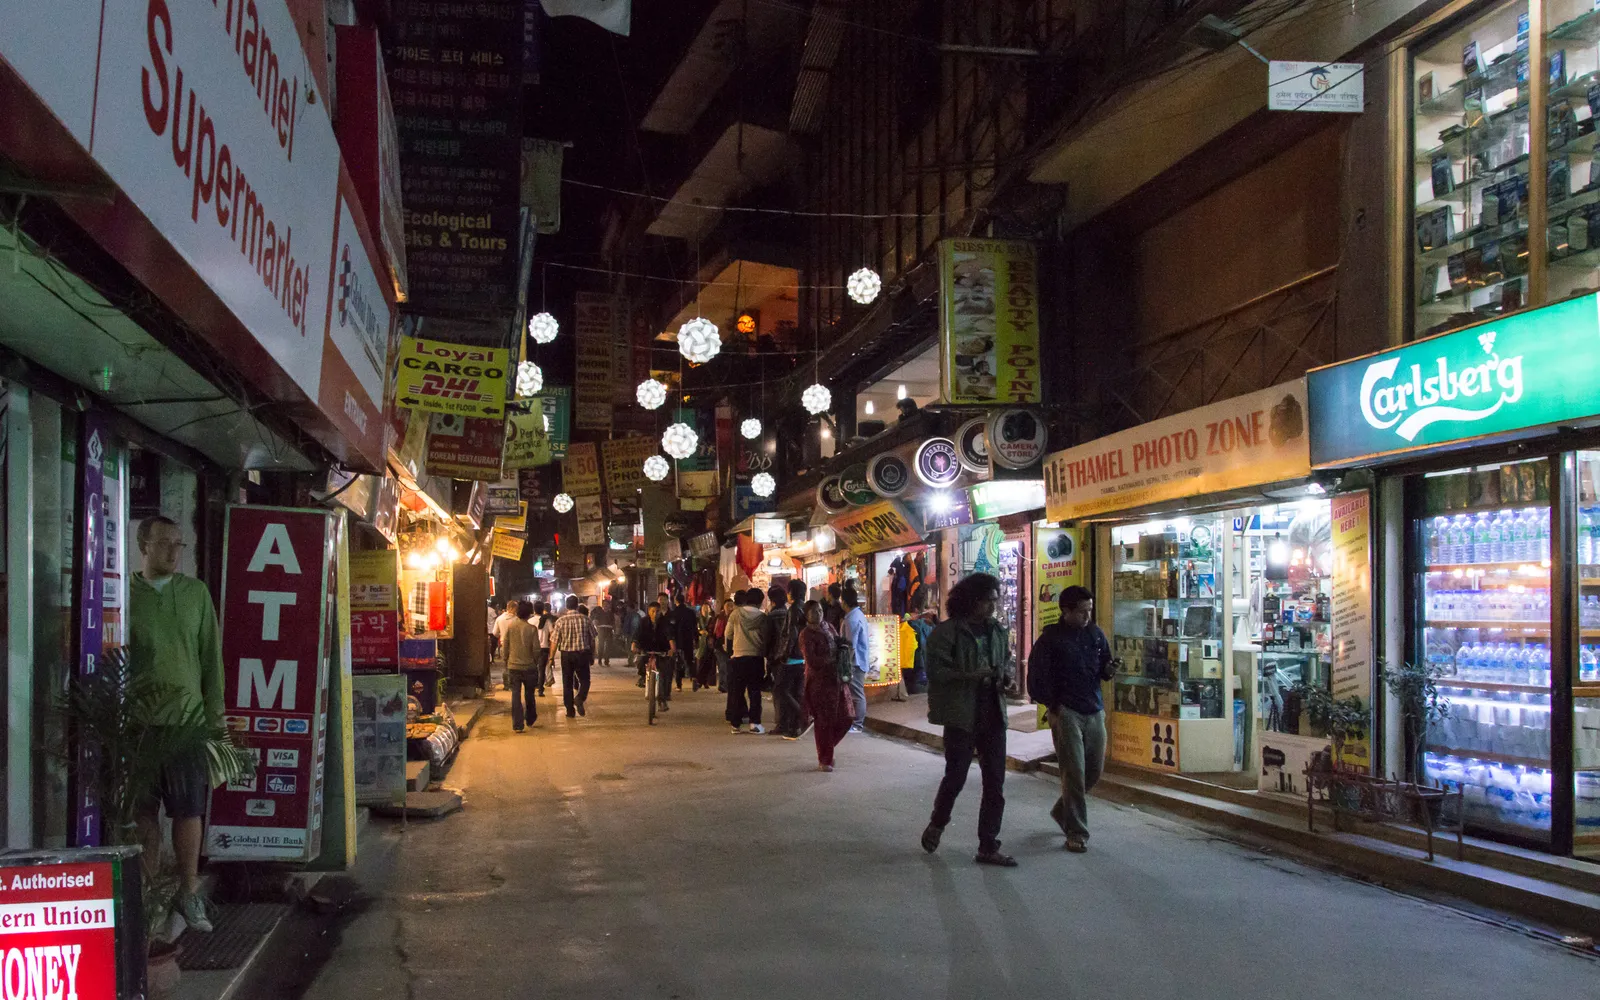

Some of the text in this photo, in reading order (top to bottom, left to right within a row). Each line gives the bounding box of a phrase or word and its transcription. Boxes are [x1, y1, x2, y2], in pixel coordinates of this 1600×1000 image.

[440, 50, 464, 65] 포터
[470, 52, 505, 66] 서비스
[141, 0, 310, 338] Supermarket
[402, 208, 492, 231] Ecological
[439, 231, 452, 248] &
[458, 232, 509, 250] Tours
[954, 241, 1004, 253] SIESTA
[415, 341, 494, 362] Loyal
[403, 357, 503, 379] CARGO
[1006, 344, 1036, 405] POINT
[420, 373, 482, 401] DHL
[1360, 352, 1524, 430] Carlsberg
[456, 403, 477, 412] FLOOR
[1000, 442, 1039, 451] CAMERA
[1006, 450, 1033, 458] STORE
[1067, 447, 1129, 489] THAMEL
[1132, 427, 1199, 474] PHOTO
[1205, 409, 1269, 456] ZONE
[429, 451, 456, 462] KOREAN
[457, 453, 500, 465] RESTAURANT
[611, 457, 643, 470] E-MAI
[613, 470, 645, 482] PHO
[1333, 495, 1367, 520] AVAILABLE
[843, 511, 910, 546] OCTOPUS
[1041, 560, 1077, 570] CAMERA
[1045, 569, 1073, 579] STORE
[237, 522, 302, 711] ATM
[273, 751, 295, 761] VISA
[275, 783, 295, 793] PLUS
[233, 835, 304, 846] Global IME Bank
[11, 870, 94, 891] Authorised
[0, 905, 107, 929] ern Union
